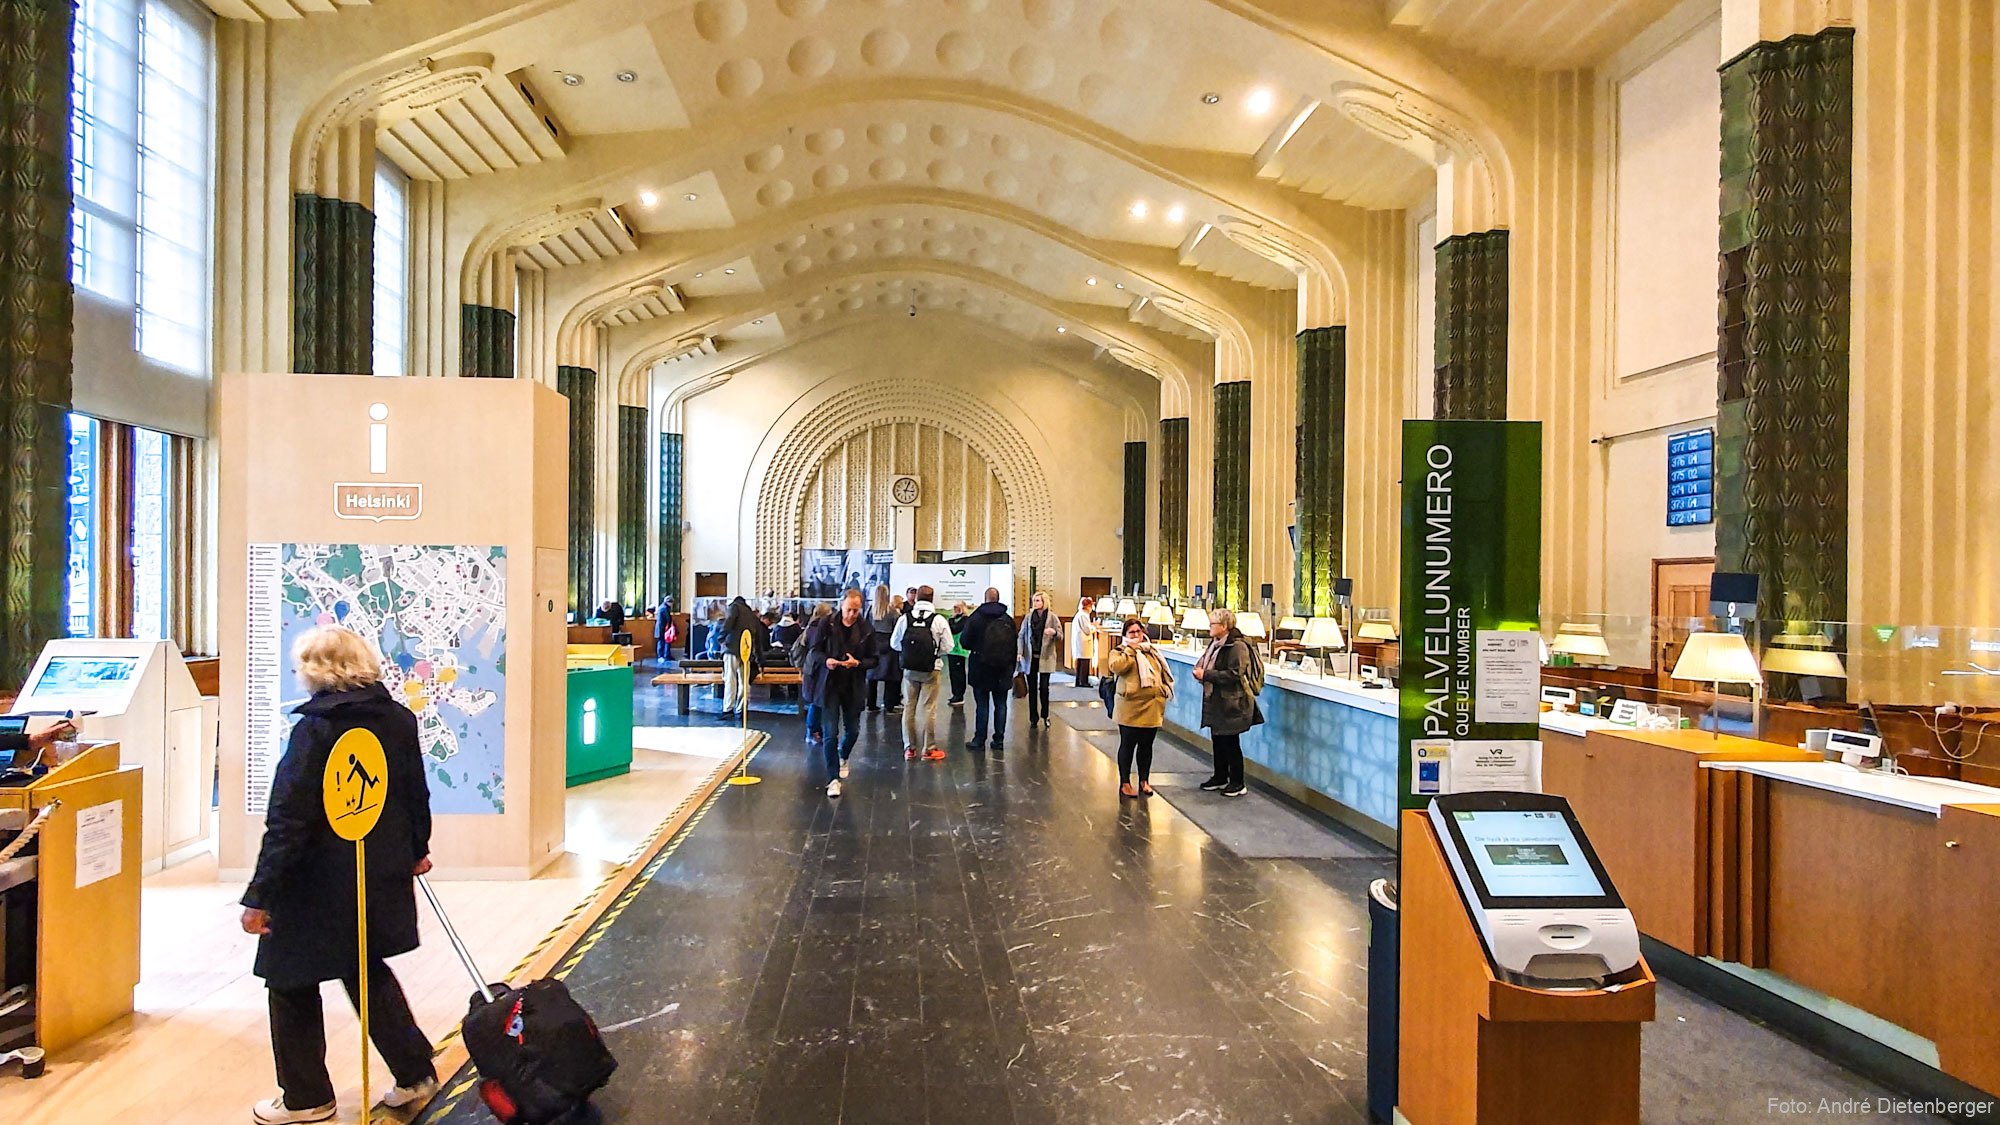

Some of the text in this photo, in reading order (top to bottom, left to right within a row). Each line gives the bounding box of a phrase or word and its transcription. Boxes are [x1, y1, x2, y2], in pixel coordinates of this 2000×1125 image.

[1671, 442, 1685, 453] 377
[1671, 456, 1685, 468] 376
[1671, 470, 1685, 482] 375
[1671, 485, 1684, 496] 374
[346, 493, 410, 509] Helsinki
[1671, 499, 1684, 510] 373
[1670, 514, 1684, 524] 372
[949, 569, 966, 577] VR
[1424, 444, 1453, 736] PALVELUNUMERO
[1727, 602, 1736, 617] 9
[1456, 607, 1471, 736] QUEUE NUMBER
